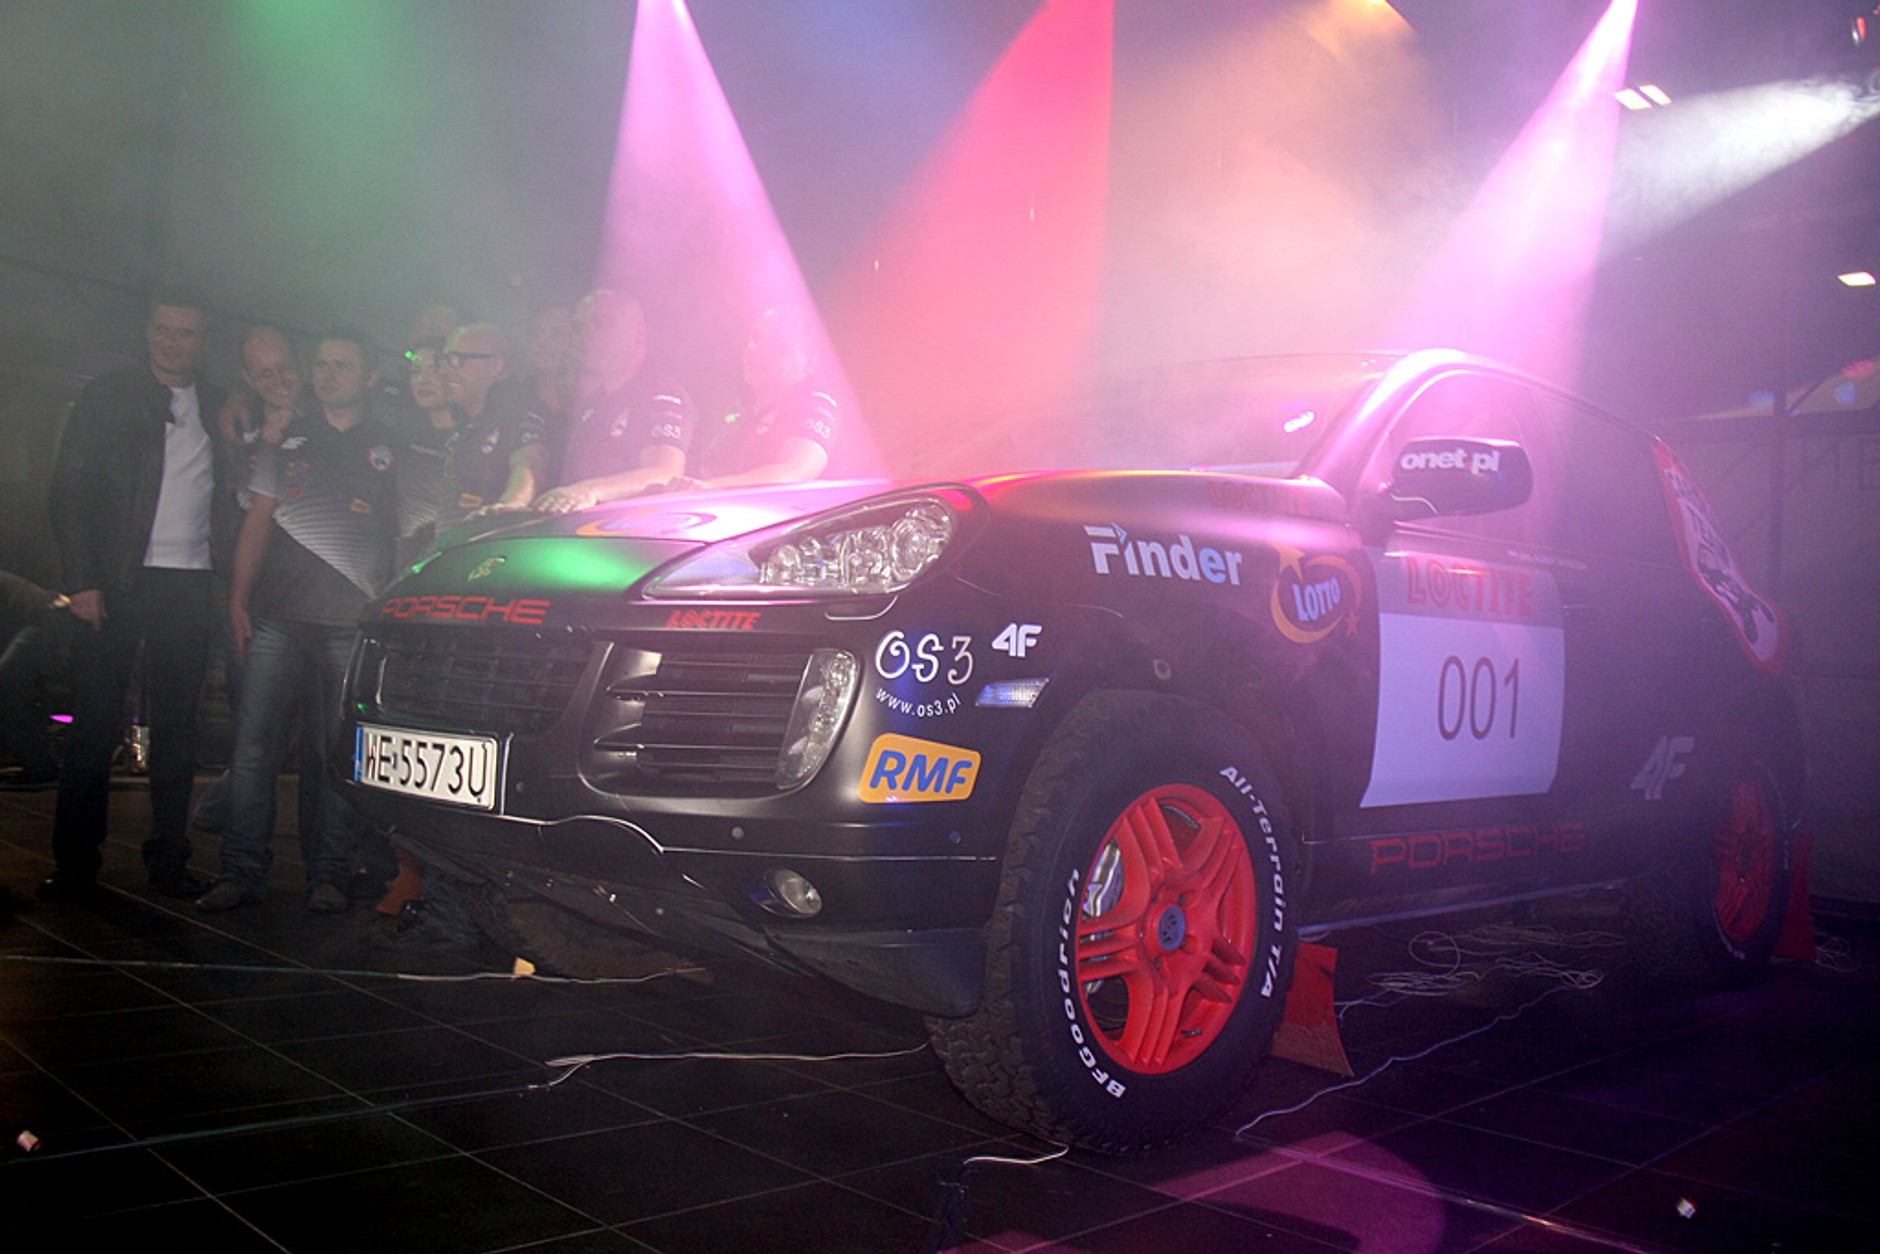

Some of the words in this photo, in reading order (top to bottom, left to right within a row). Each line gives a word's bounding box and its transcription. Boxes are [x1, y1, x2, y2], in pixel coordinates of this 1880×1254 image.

[1083, 521, 1243, 586] Finder
[378, 595, 551, 626] PORSCHE
[1404, 555, 1535, 617] LOCTITE
[665, 609, 761, 631] LOCTITE
[991, 622, 1043, 658] 4F
[874, 630, 974, 685] OS3
[875, 687, 962, 718] www.os3.pl
[1437, 655, 1520, 741] 001
[869, 750, 973, 794] RMF
[1629, 735, 1696, 800] 4F
[1370, 822, 1585, 876] PORSCHE
[1057, 867, 1127, 1099] BFGoodrich
